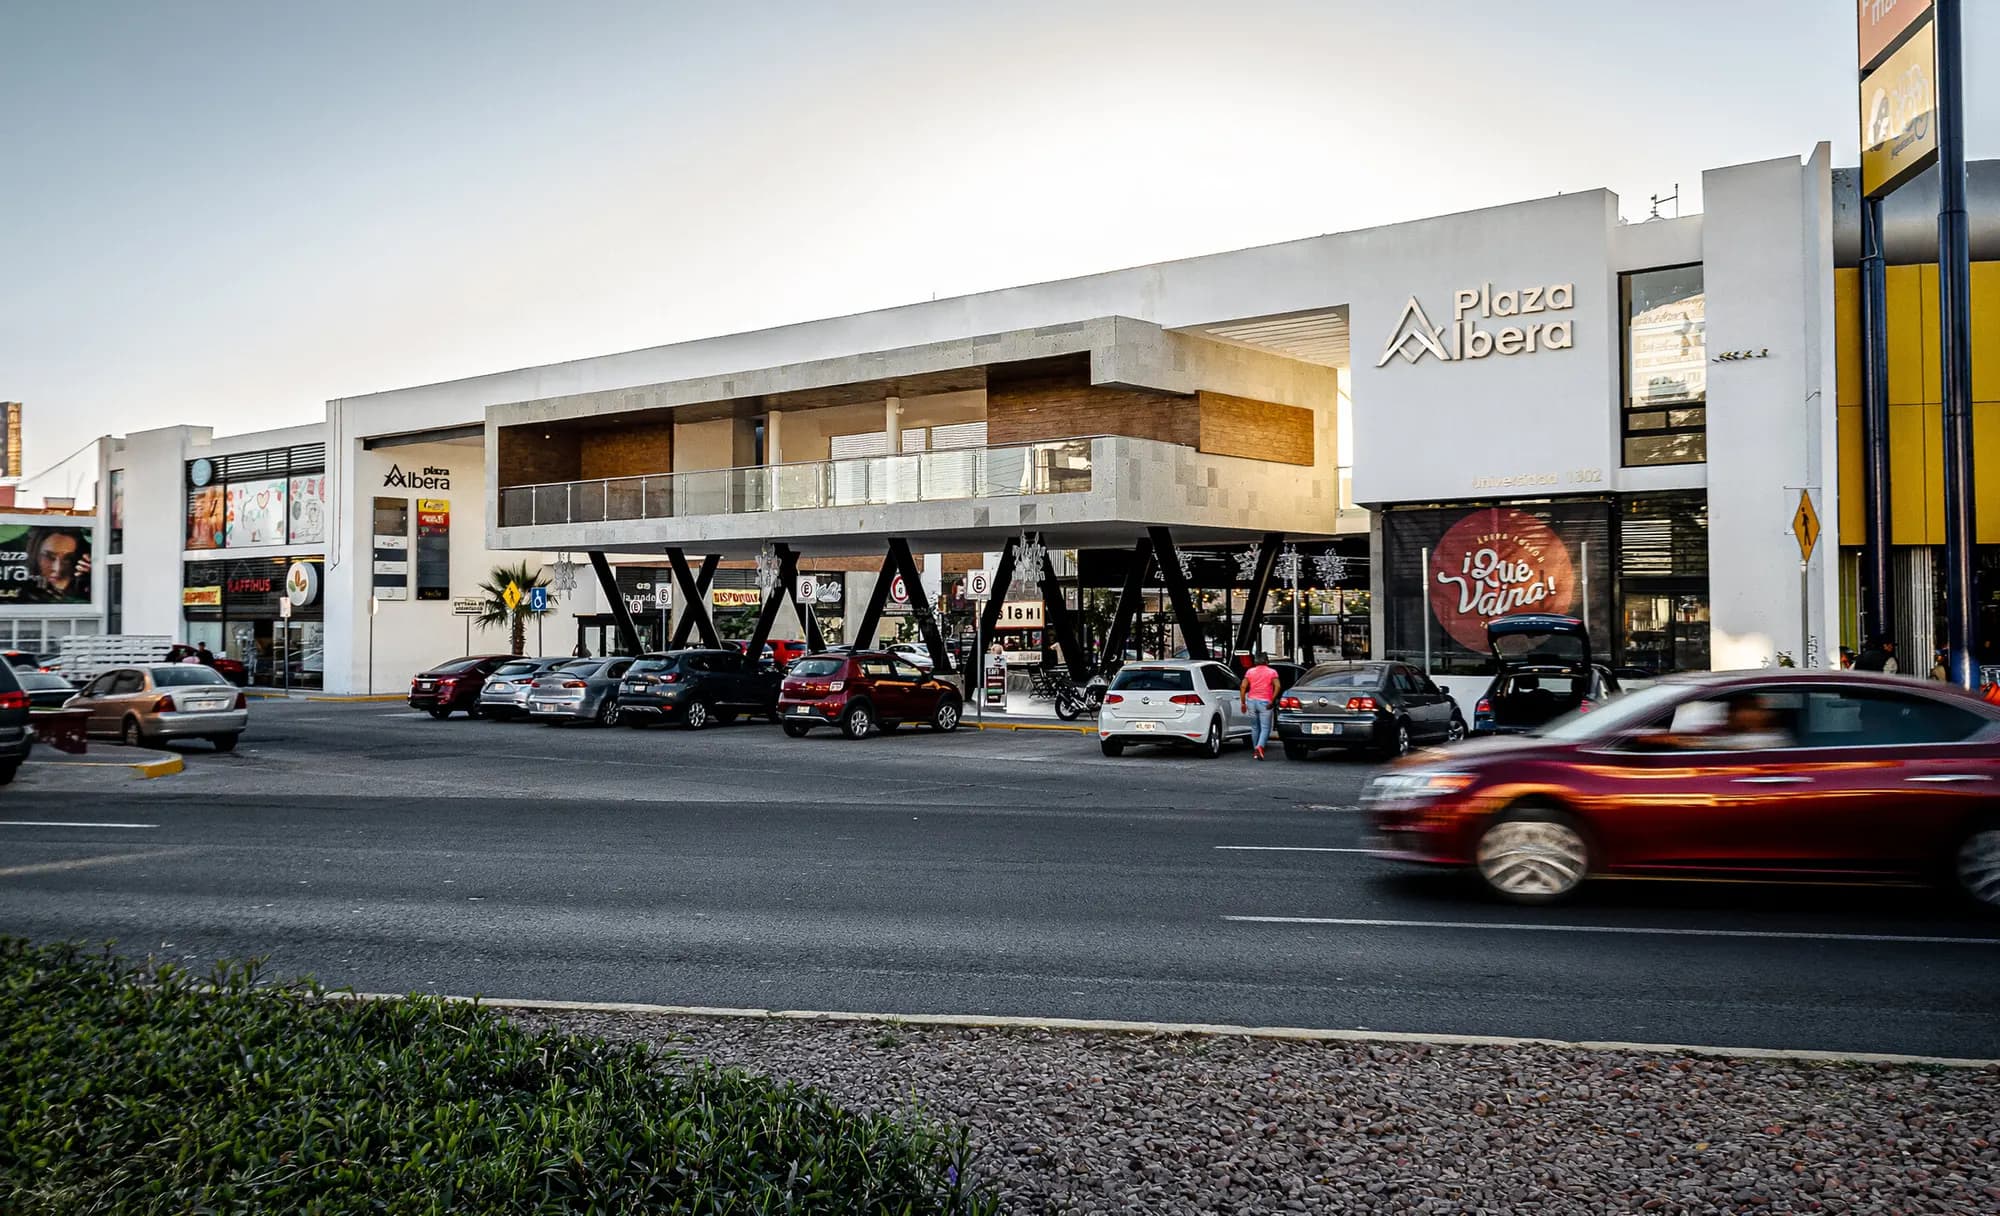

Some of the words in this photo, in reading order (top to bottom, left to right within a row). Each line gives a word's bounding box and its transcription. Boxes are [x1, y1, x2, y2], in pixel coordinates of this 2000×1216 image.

[1454, 282, 1574, 321] Plaza
[1462, 548, 1534, 588] ¡Qué
[1437, 575, 1557, 617] Vaina!
